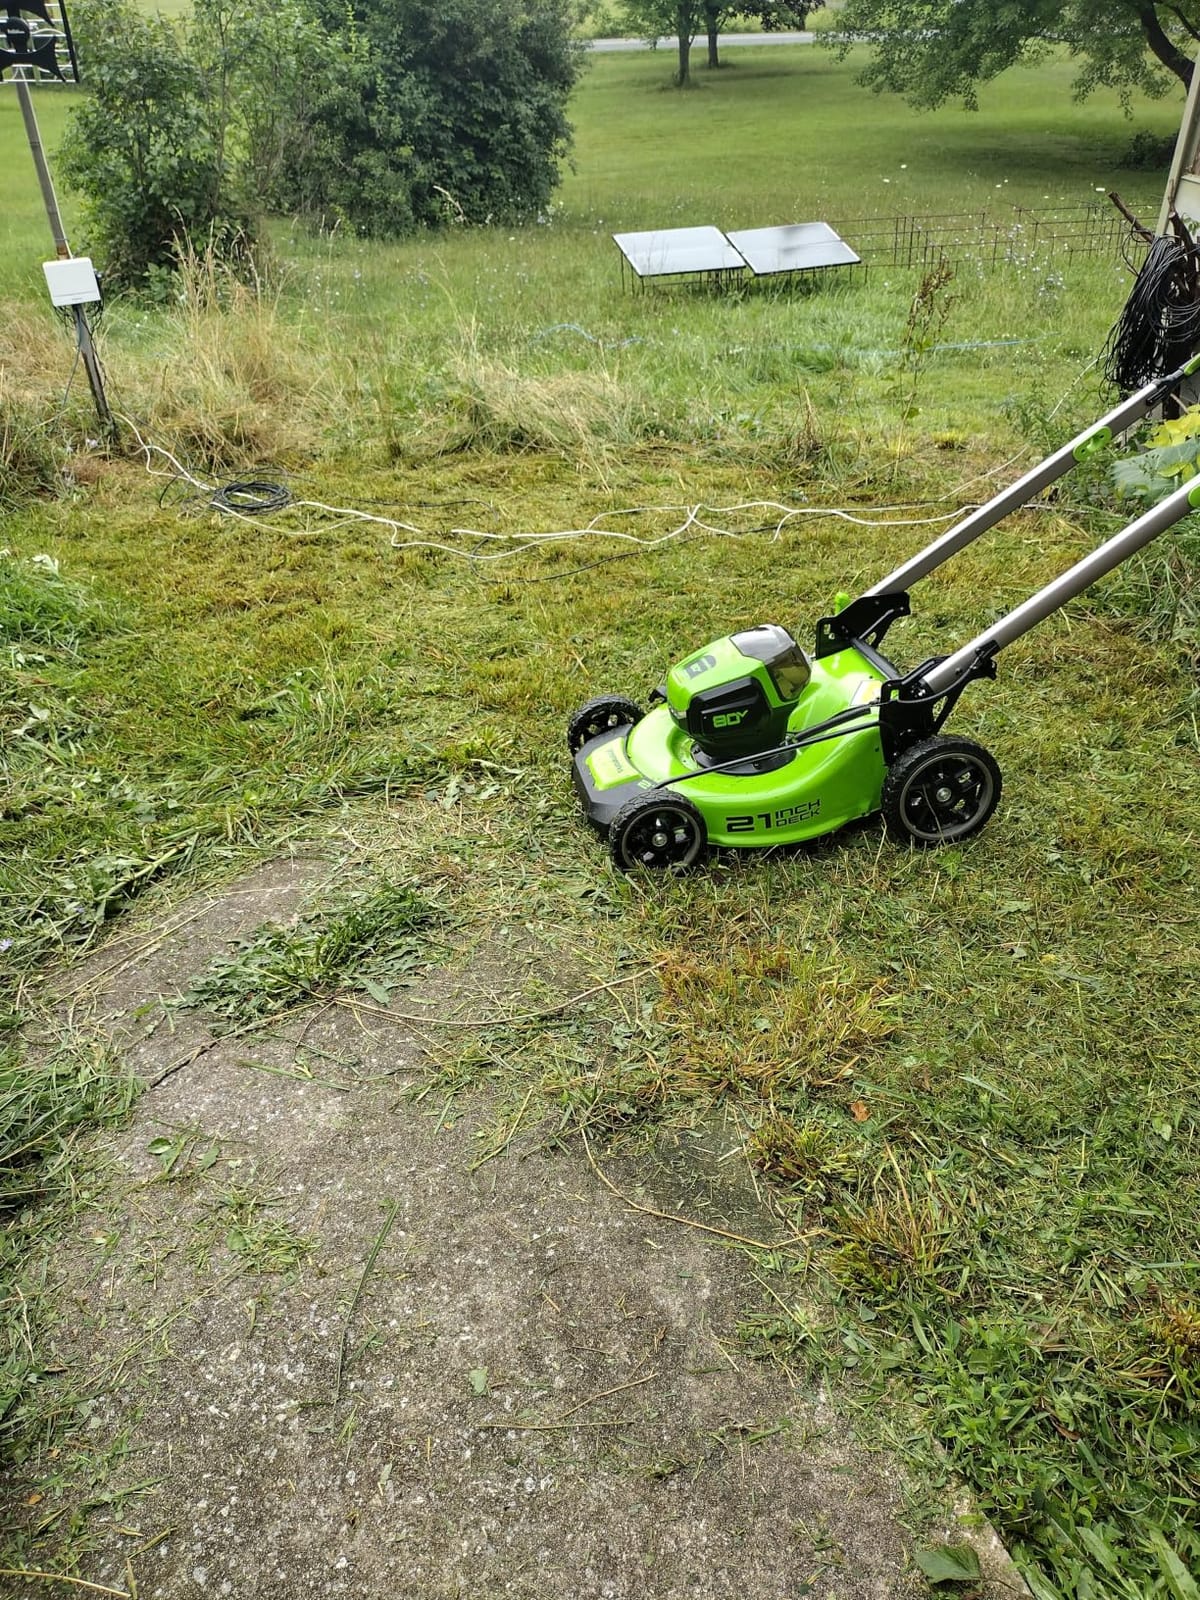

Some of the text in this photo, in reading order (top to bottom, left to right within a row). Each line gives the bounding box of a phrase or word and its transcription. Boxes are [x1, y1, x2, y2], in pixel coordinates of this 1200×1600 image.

[726, 799, 821, 833] 21 INCH
[775, 808, 821, 827] DECK
